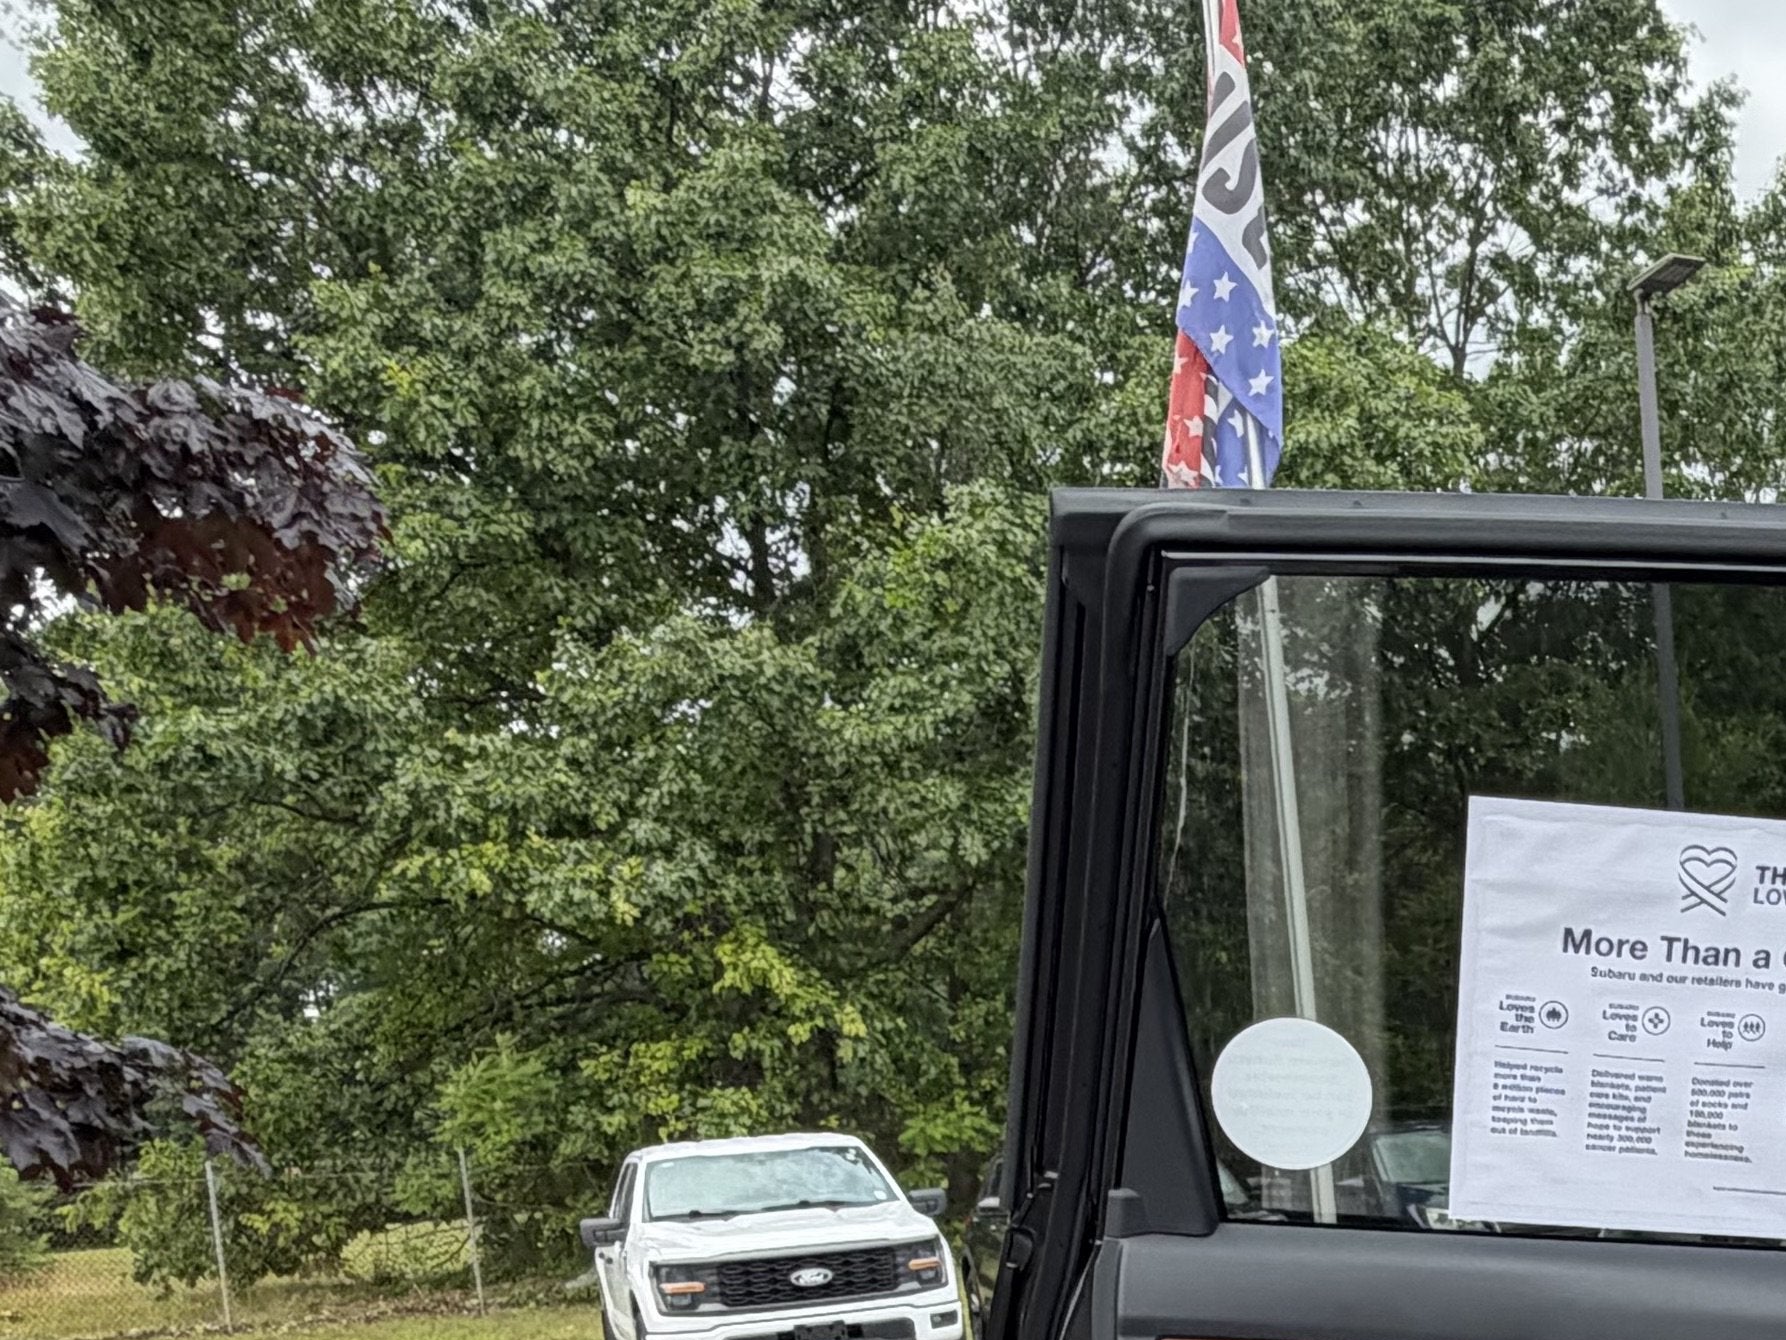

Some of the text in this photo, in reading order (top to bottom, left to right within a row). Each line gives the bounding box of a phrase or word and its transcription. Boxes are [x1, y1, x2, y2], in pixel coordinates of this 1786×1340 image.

[1561, 927, 1648, 960] More
[1660, 935, 1741, 969] Than
[1752, 948, 1771, 969] a
[1590, 966, 1635, 981] Subaru
[1639, 972, 1663, 983] and
[1666, 974, 1688, 984] our
[1691, 976, 1741, 988] retailers
[1745, 978, 1775, 991] have
[1499, 1001, 1535, 1013] Loves
[1515, 1013, 1534, 1023] the
[1603, 1010, 1638, 1022] Loves
[1500, 1022, 1534, 1034] Earth
[1625, 1023, 1637, 1032] to
[1700, 1018, 1734, 1029] Loves
[1608, 1031, 1636, 1042] Care
[1722, 1031, 1733, 1039] to
[1707, 1039, 1733, 1052] Help
